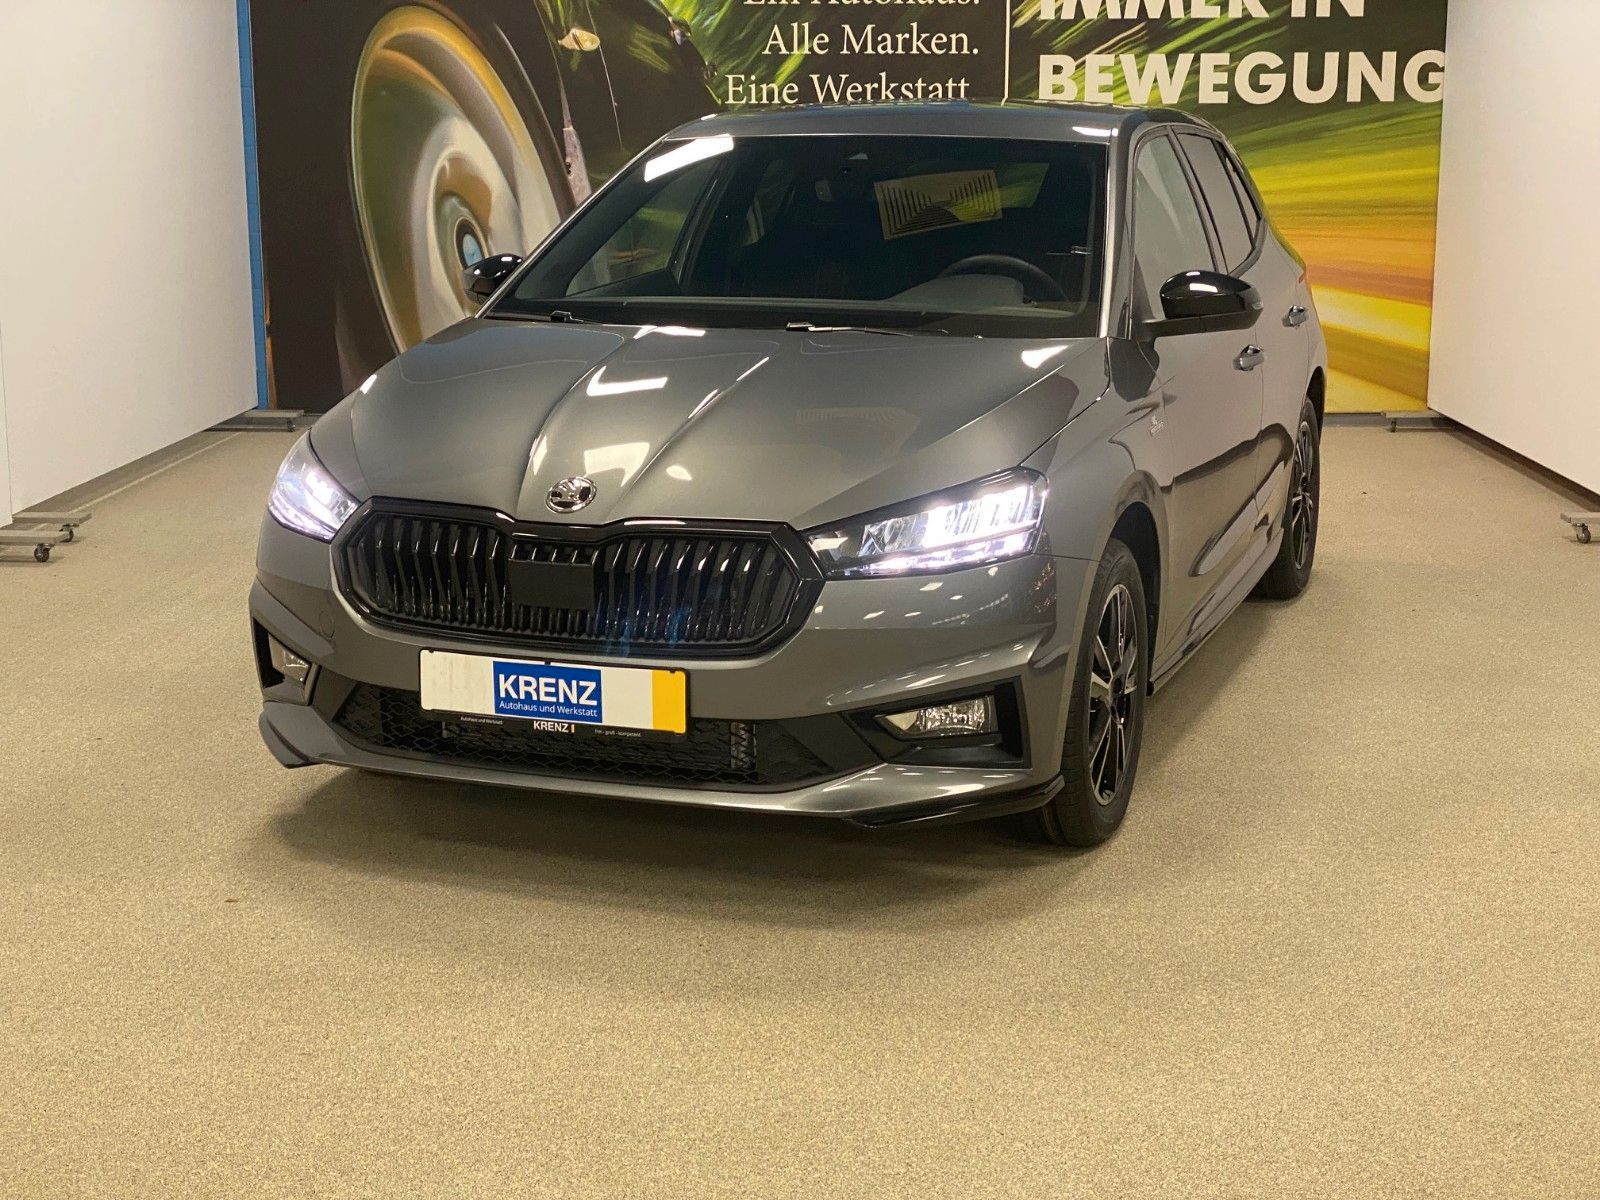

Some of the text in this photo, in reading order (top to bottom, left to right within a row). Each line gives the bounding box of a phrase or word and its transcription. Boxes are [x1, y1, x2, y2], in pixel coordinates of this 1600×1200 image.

[762, 22, 979, 55] Alle Marken.
[724, 73, 799, 104] Eine
[1039, 50, 1445, 104] BEWEGUNG
[498, 674, 598, 706] KRENZ
[499, 701, 598, 717] Autohaus und Werkstatt
[533, 720, 569, 733] KRENZ
